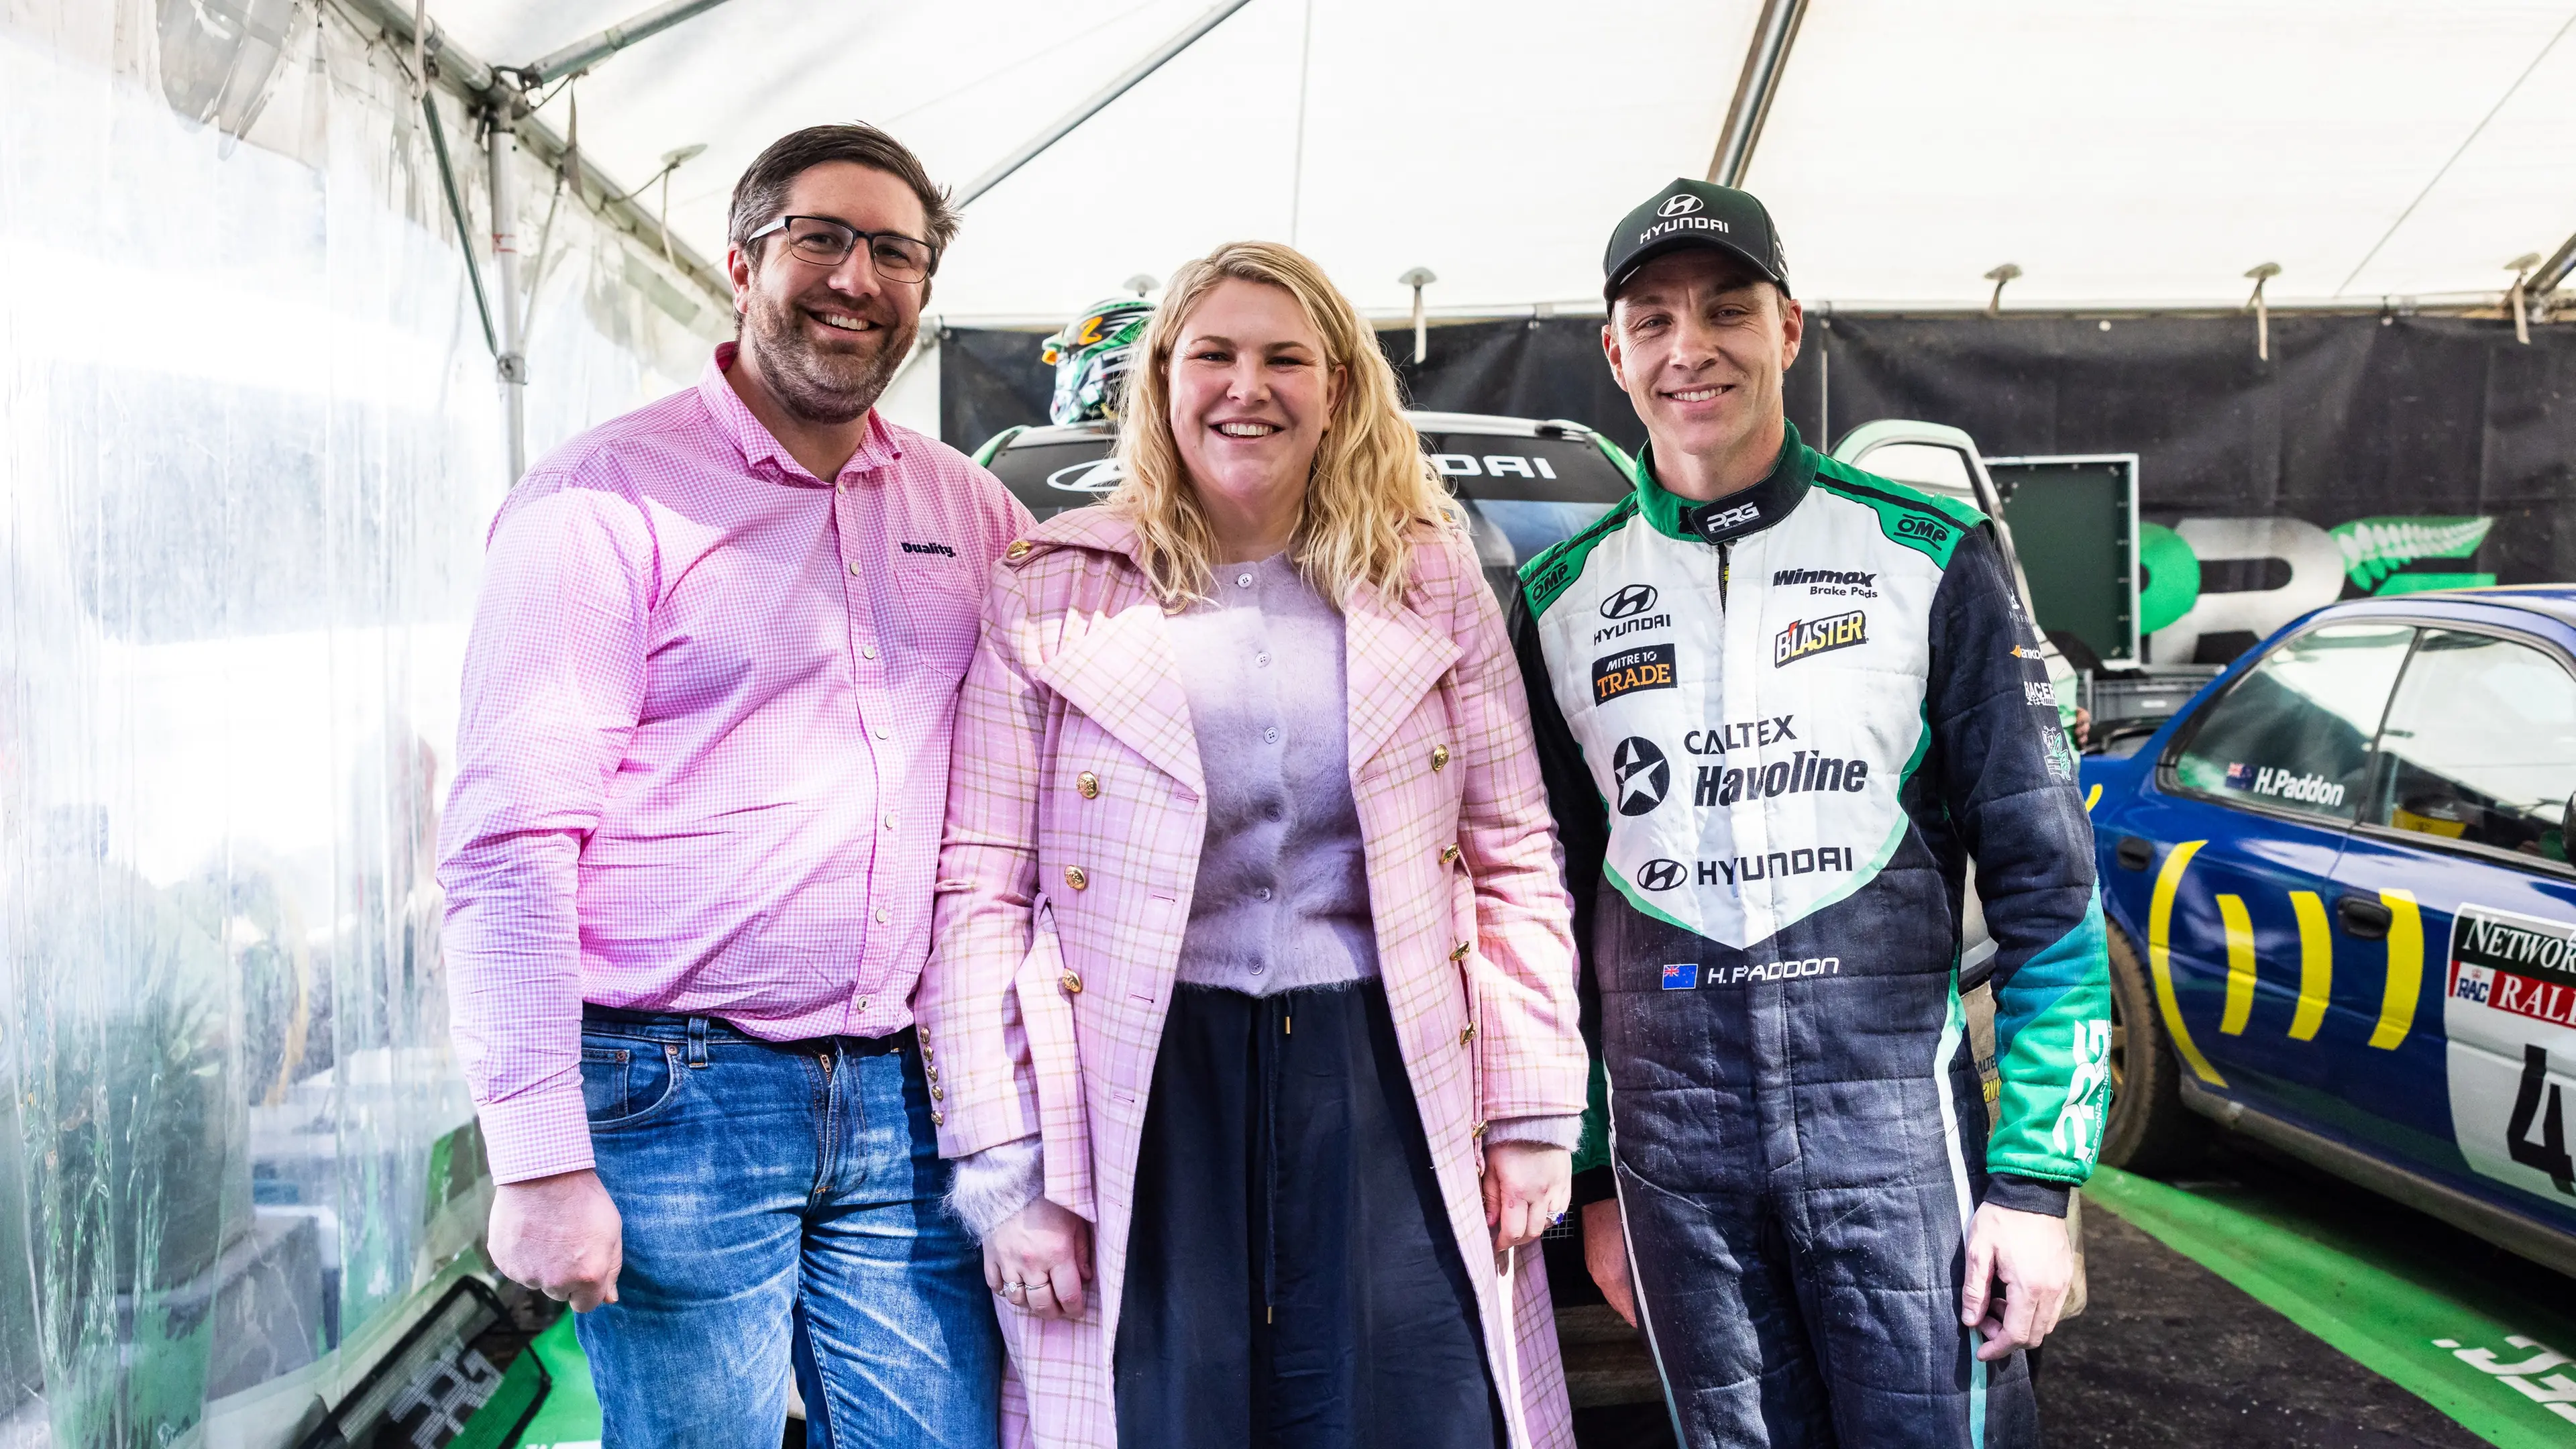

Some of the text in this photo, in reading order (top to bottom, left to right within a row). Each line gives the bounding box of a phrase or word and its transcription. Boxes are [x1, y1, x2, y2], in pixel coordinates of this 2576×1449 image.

[1640, 217, 1729, 244] HYUNDAI
[1707, 501, 1760, 532] PRG
[1897, 519, 1947, 542] OMP
[1532, 564, 1568, 601] OMP
[1773, 568, 1877, 587] Winmax
[1810, 586, 1878, 598] Brake Pads
[1593, 614, 1671, 647] HYUNDAI
[1606, 651, 1657, 672] MITRE 10
[1597, 663, 1671, 698] TRADE
[1684, 714, 1798, 755] CALTEX
[1694, 750, 1868, 806] Havoline
[2253, 766, 2345, 807] H.Paddon
[1697, 847, 1854, 885] HYUNDAI
[1707, 957, 1839, 984] H. PADDON
[2457, 977, 2489, 1004] RAC
[2051, 1019, 2111, 1163] PRG
